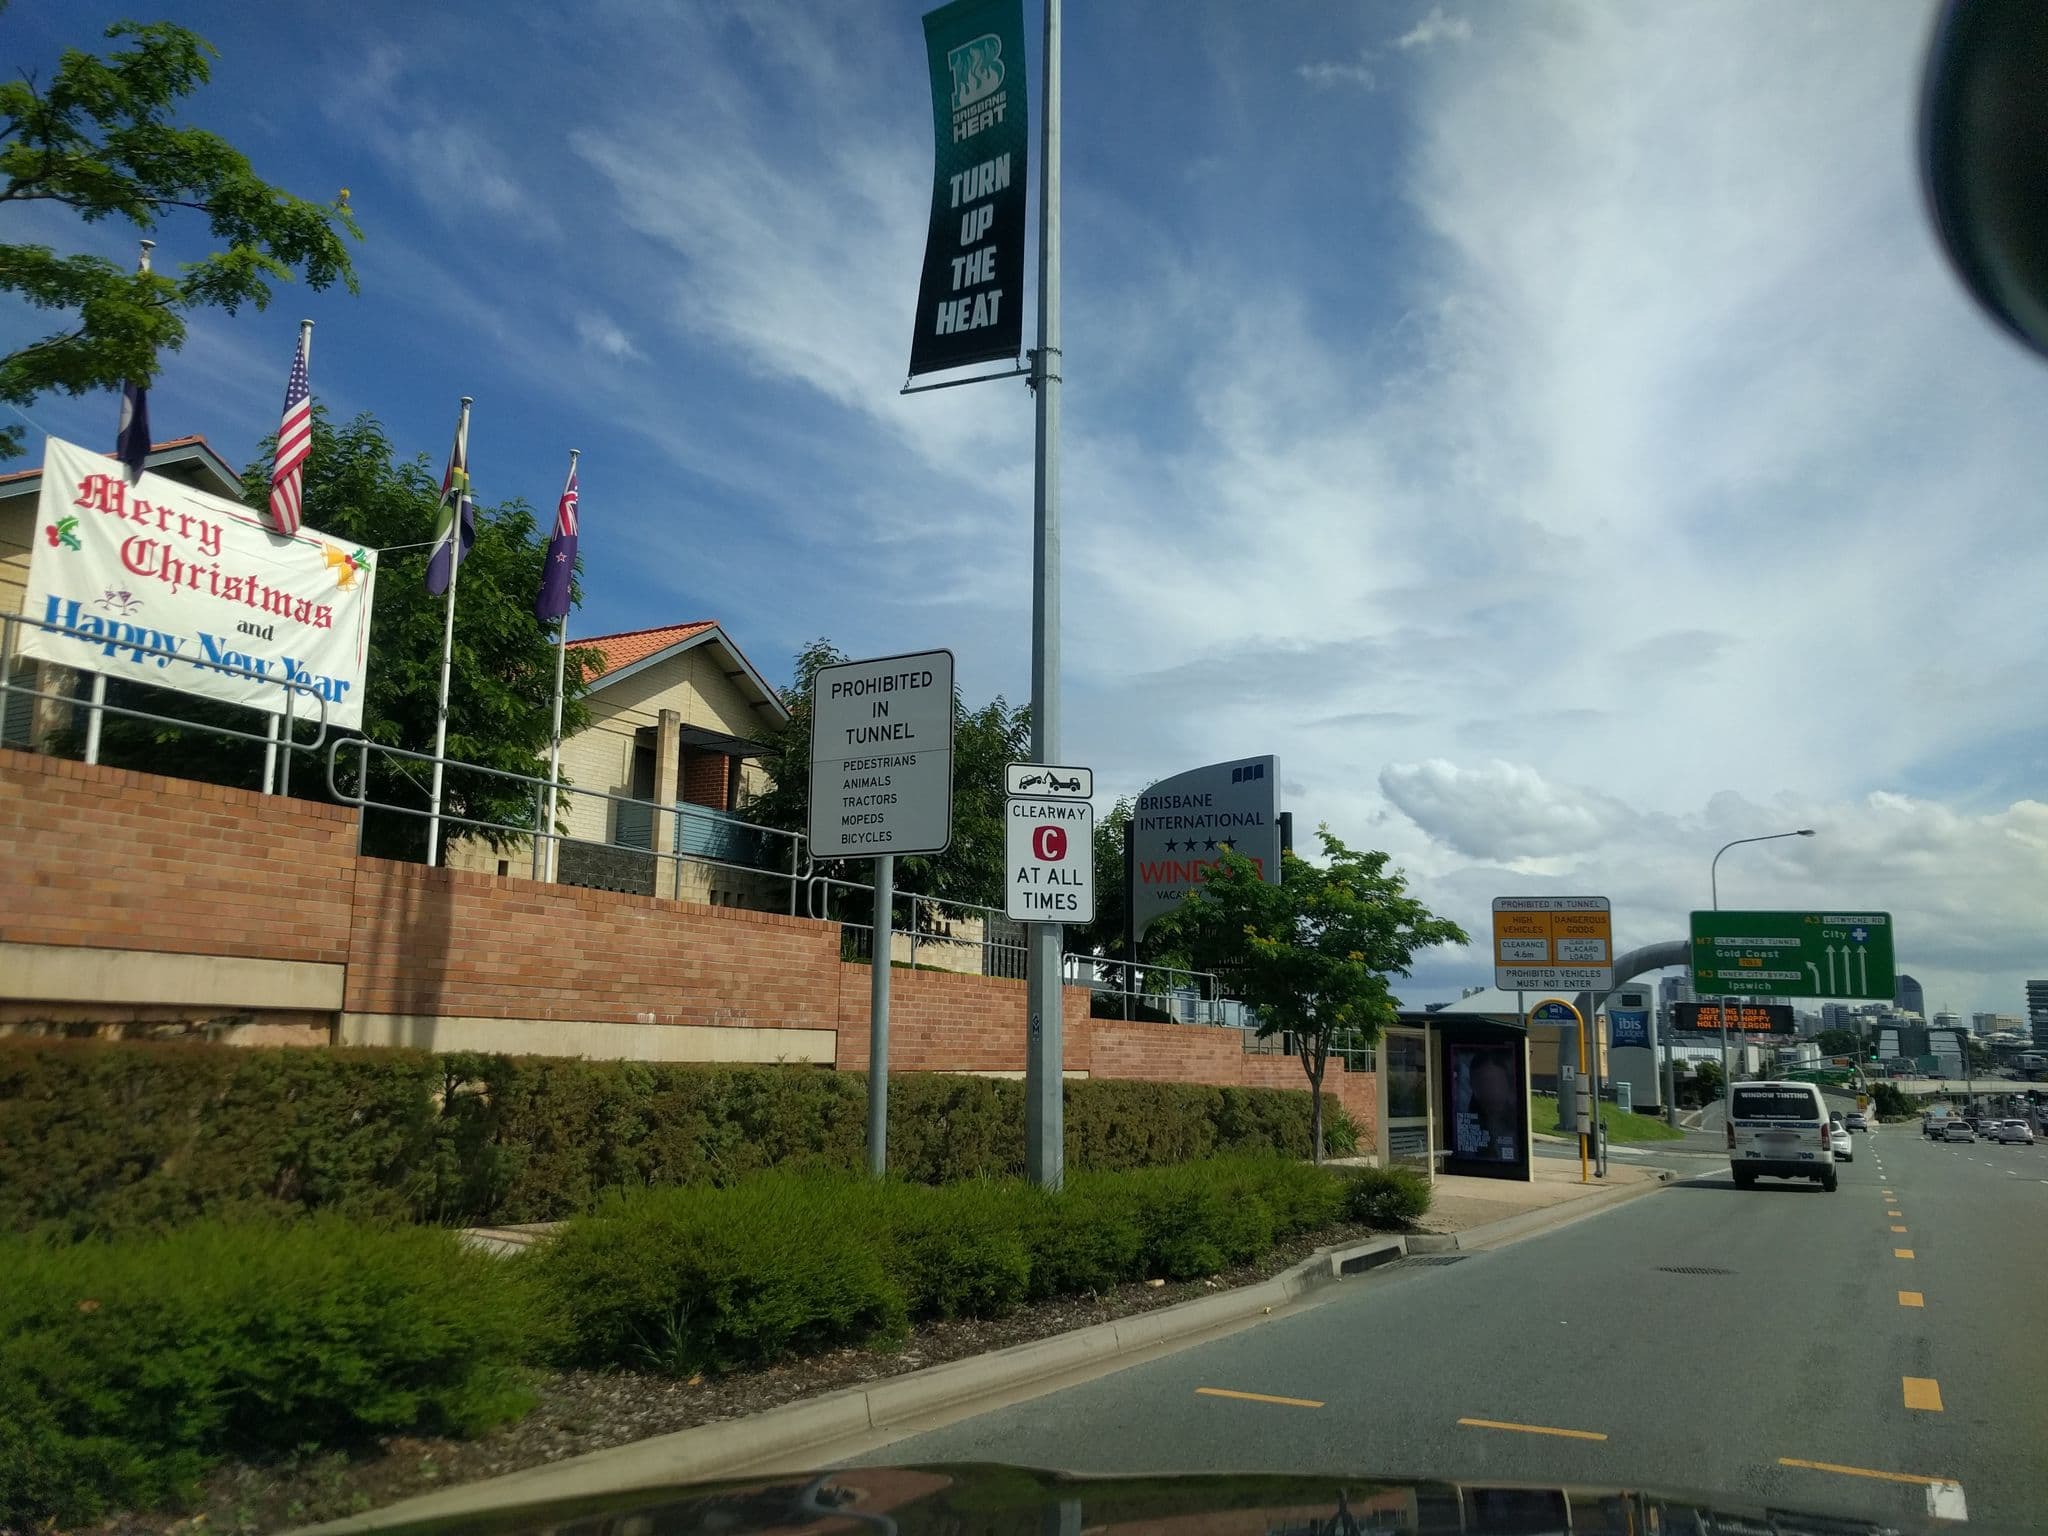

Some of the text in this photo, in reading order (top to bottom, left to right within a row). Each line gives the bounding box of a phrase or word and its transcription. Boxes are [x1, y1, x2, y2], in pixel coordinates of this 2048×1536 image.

[952, 90, 1007, 124] BRISBANE
[953, 102, 1007, 144] HEAT
[950, 152, 1011, 208] TURN
[960, 203, 993, 247] UP
[951, 246, 997, 291] THE
[935, 289, 1003, 336] HEAT
[73, 473, 224, 557] Merry
[120, 534, 333, 630] Christmas
[236, 617, 275, 641] and
[40, 594, 350, 704] Happy New Year
[831, 671, 933, 699] PROHIBITED
[872, 701, 889, 718] IN
[846, 722, 915, 744] TUNNEL
[843, 755, 917, 771] PEDESTRIANS
[843, 776, 891, 789] ANIMALS
[842, 793, 897, 807] TRACTORS
[1140, 793, 1212, 810] BRISBANE
[841, 813, 884, 826] MOPEDS
[1013, 805, 1086, 820] CLEARWAY
[1140, 812, 1265, 831] INTERNATIONAL
[841, 831, 892, 844] BICYCLES
[1041, 829, 1058, 858] C
[1017, 867, 1083, 886] AT ALL
[1023, 892, 1078, 911] TIMES
[1567, 925, 1594, 933] GOODS
[1822, 930, 1847, 940] City
[1716, 949, 1780, 958] Gold Coast
[1728, 981, 1771, 990] Ipswich
[1619, 1018, 1642, 1029] ibis
